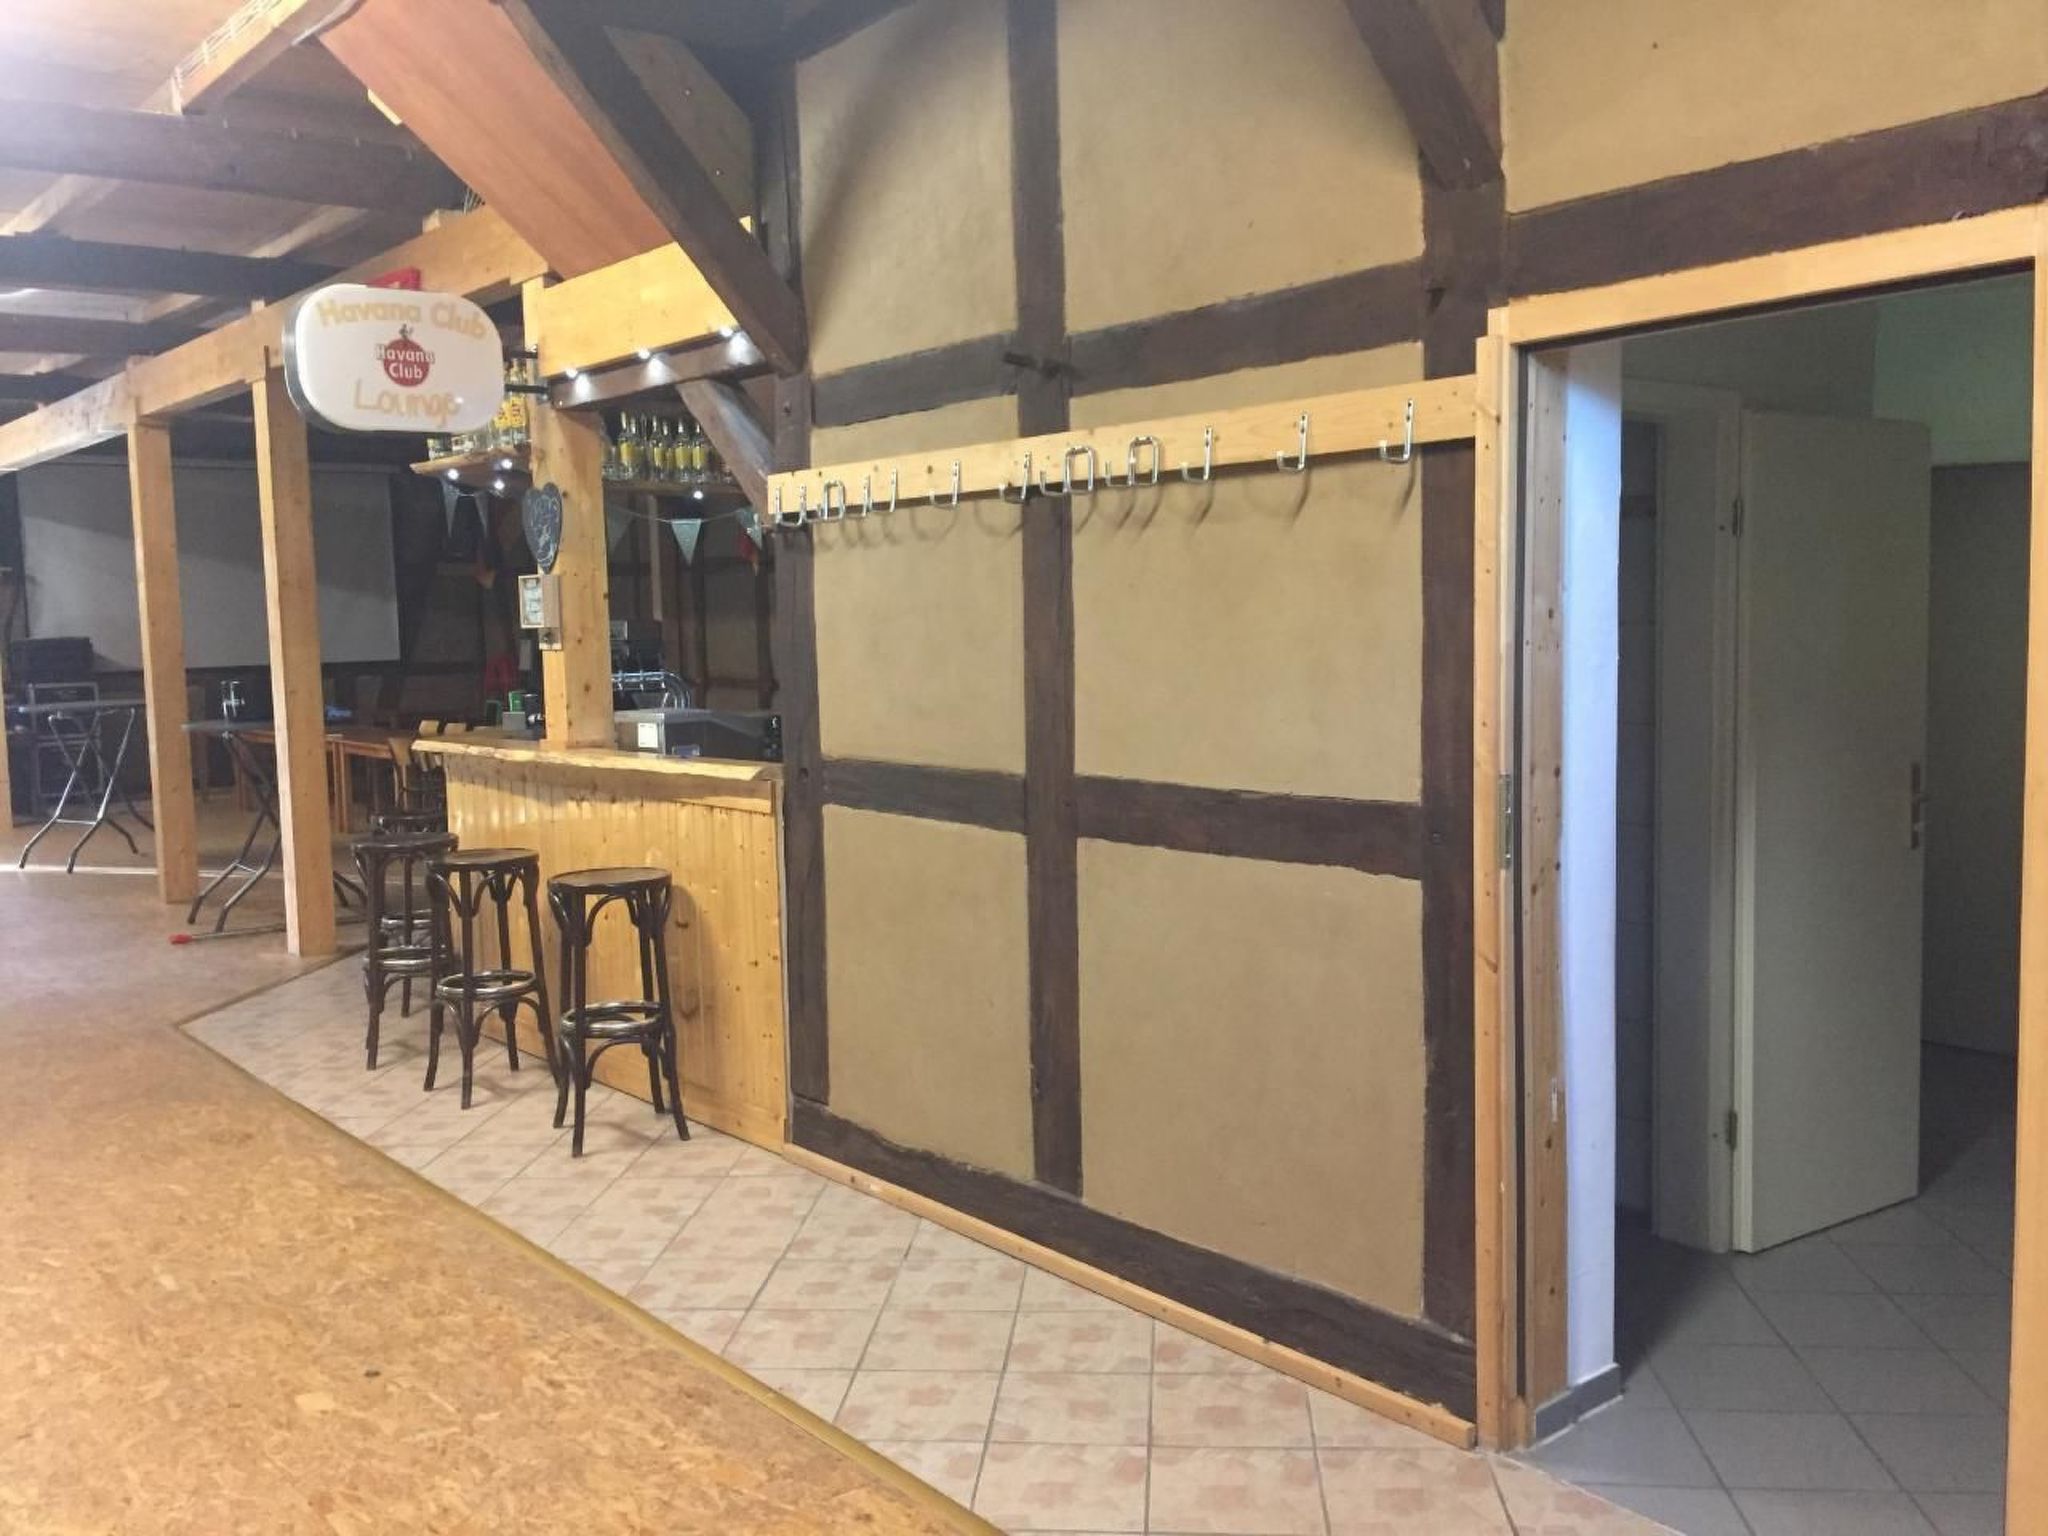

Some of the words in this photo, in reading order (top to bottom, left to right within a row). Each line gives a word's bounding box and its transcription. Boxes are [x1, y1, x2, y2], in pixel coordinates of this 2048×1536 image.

[317, 299, 422, 327] Havana
[429, 301, 488, 340] Club
[375, 343, 436, 364] Havana
[388, 362, 423, 380] Club
